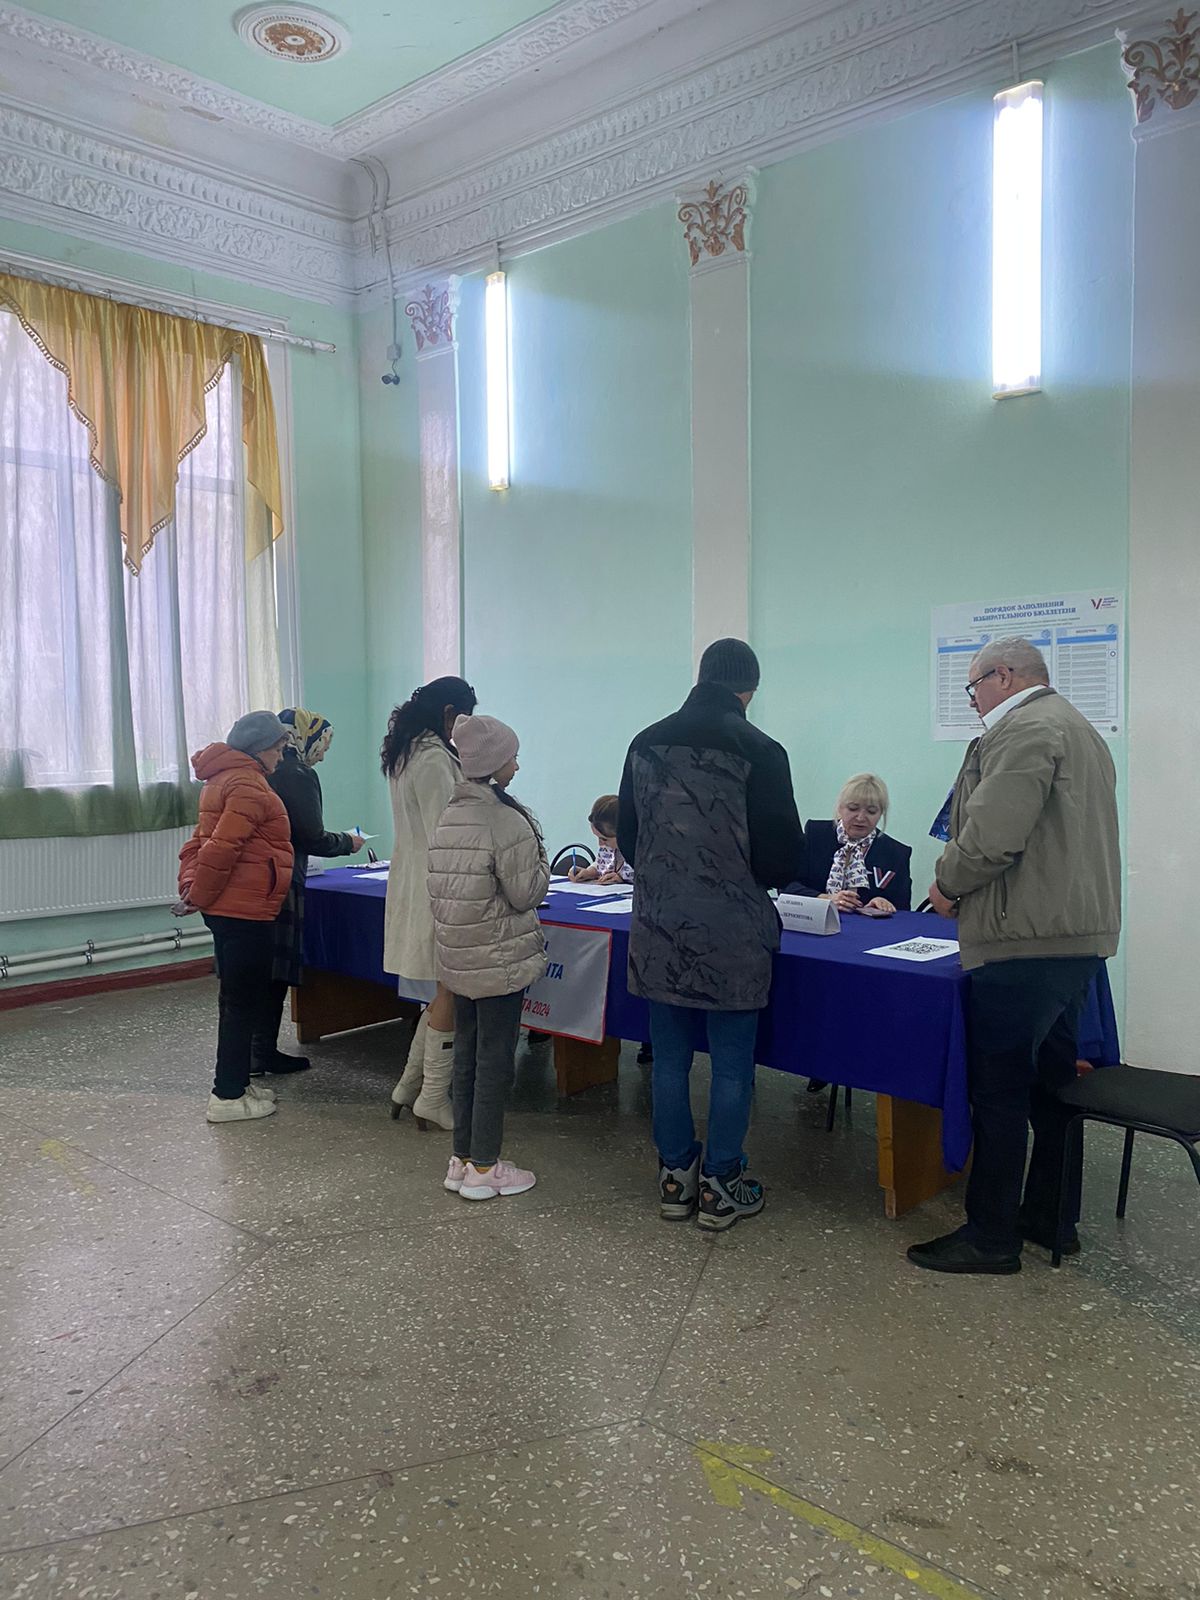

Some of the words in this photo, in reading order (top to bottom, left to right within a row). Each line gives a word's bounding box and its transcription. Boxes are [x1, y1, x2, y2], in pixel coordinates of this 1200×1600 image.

[973, 611, 1032, 622] ИЗБИРАТЕЛЬНОГО
[1033, 607, 1076, 617] БЮЛЛЕТЕНЯ
[984, 605, 1016, 614] ПОРЯДОК
[1017, 600, 1064, 611] ЗАПОЛНЕНИЯ
[532, 1001, 551, 1017] 2024
